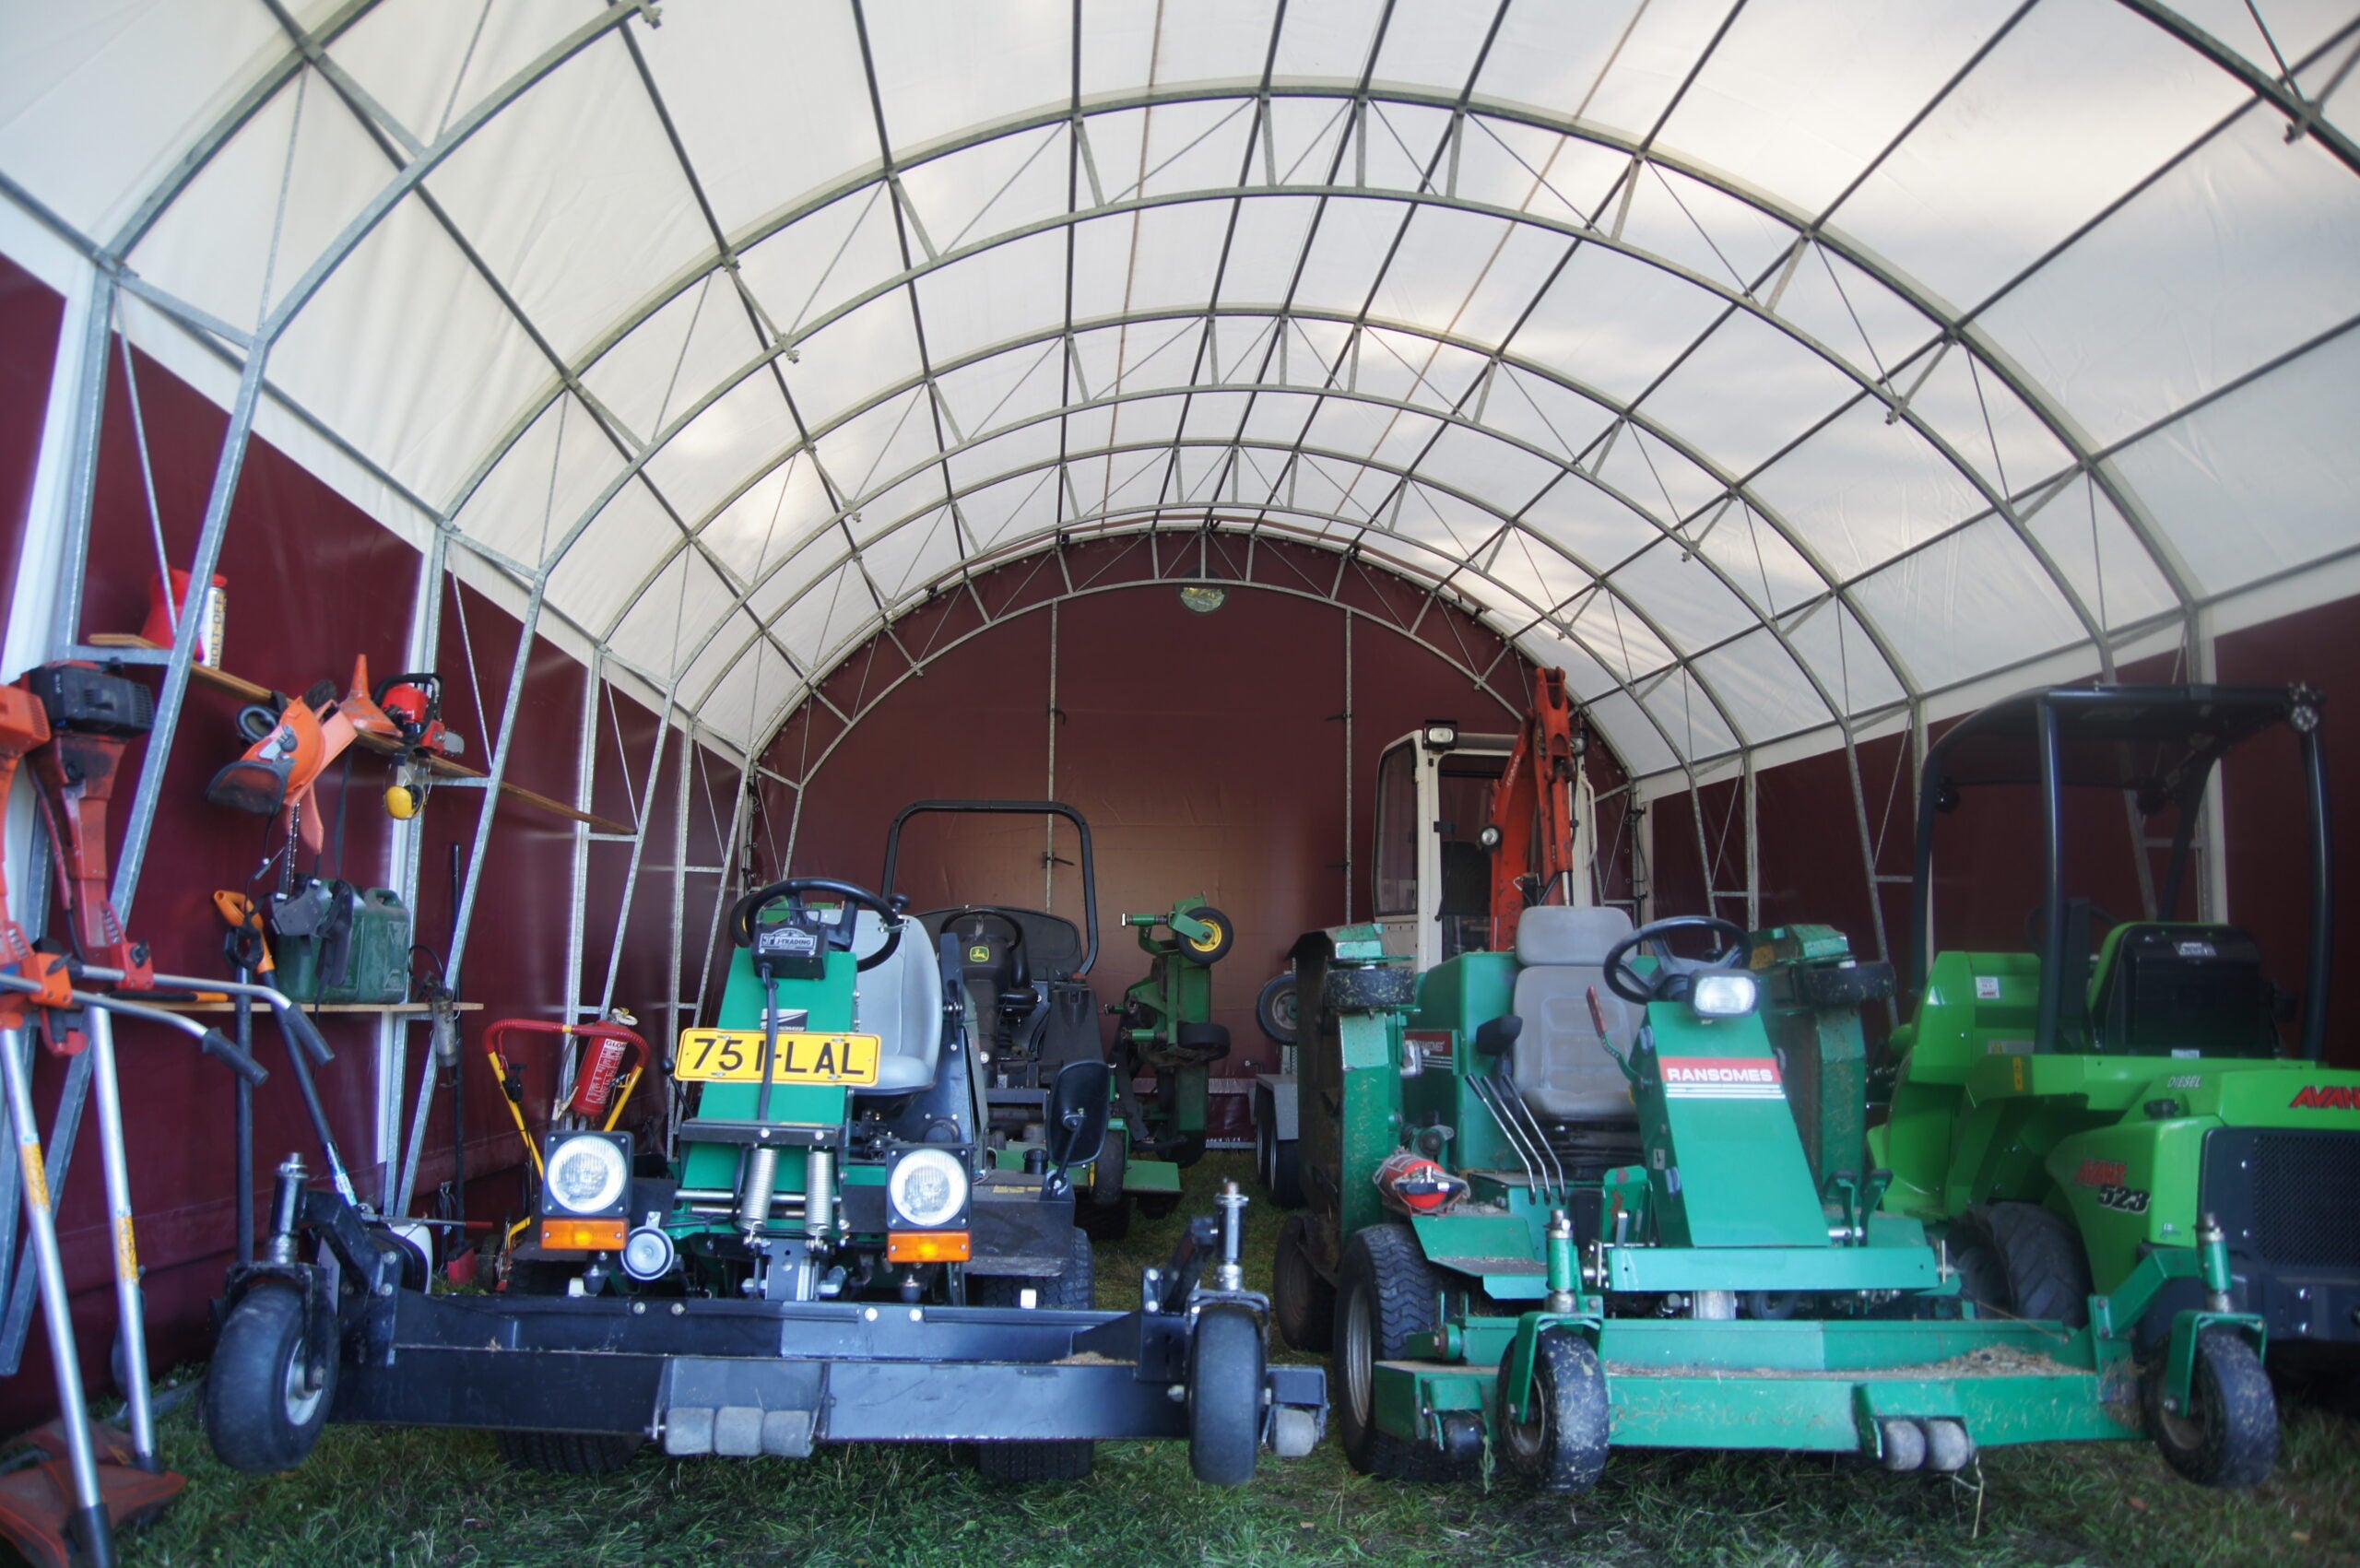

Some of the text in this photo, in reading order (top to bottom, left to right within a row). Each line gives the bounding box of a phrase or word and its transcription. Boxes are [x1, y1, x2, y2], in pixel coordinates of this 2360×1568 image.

[1667, 1067, 1773, 1081] RANSOMES
[2167, 1076, 2201, 1088] DIESEL
[2074, 1160, 2126, 1186] AVANT
[2098, 1184, 2152, 1214] 523
